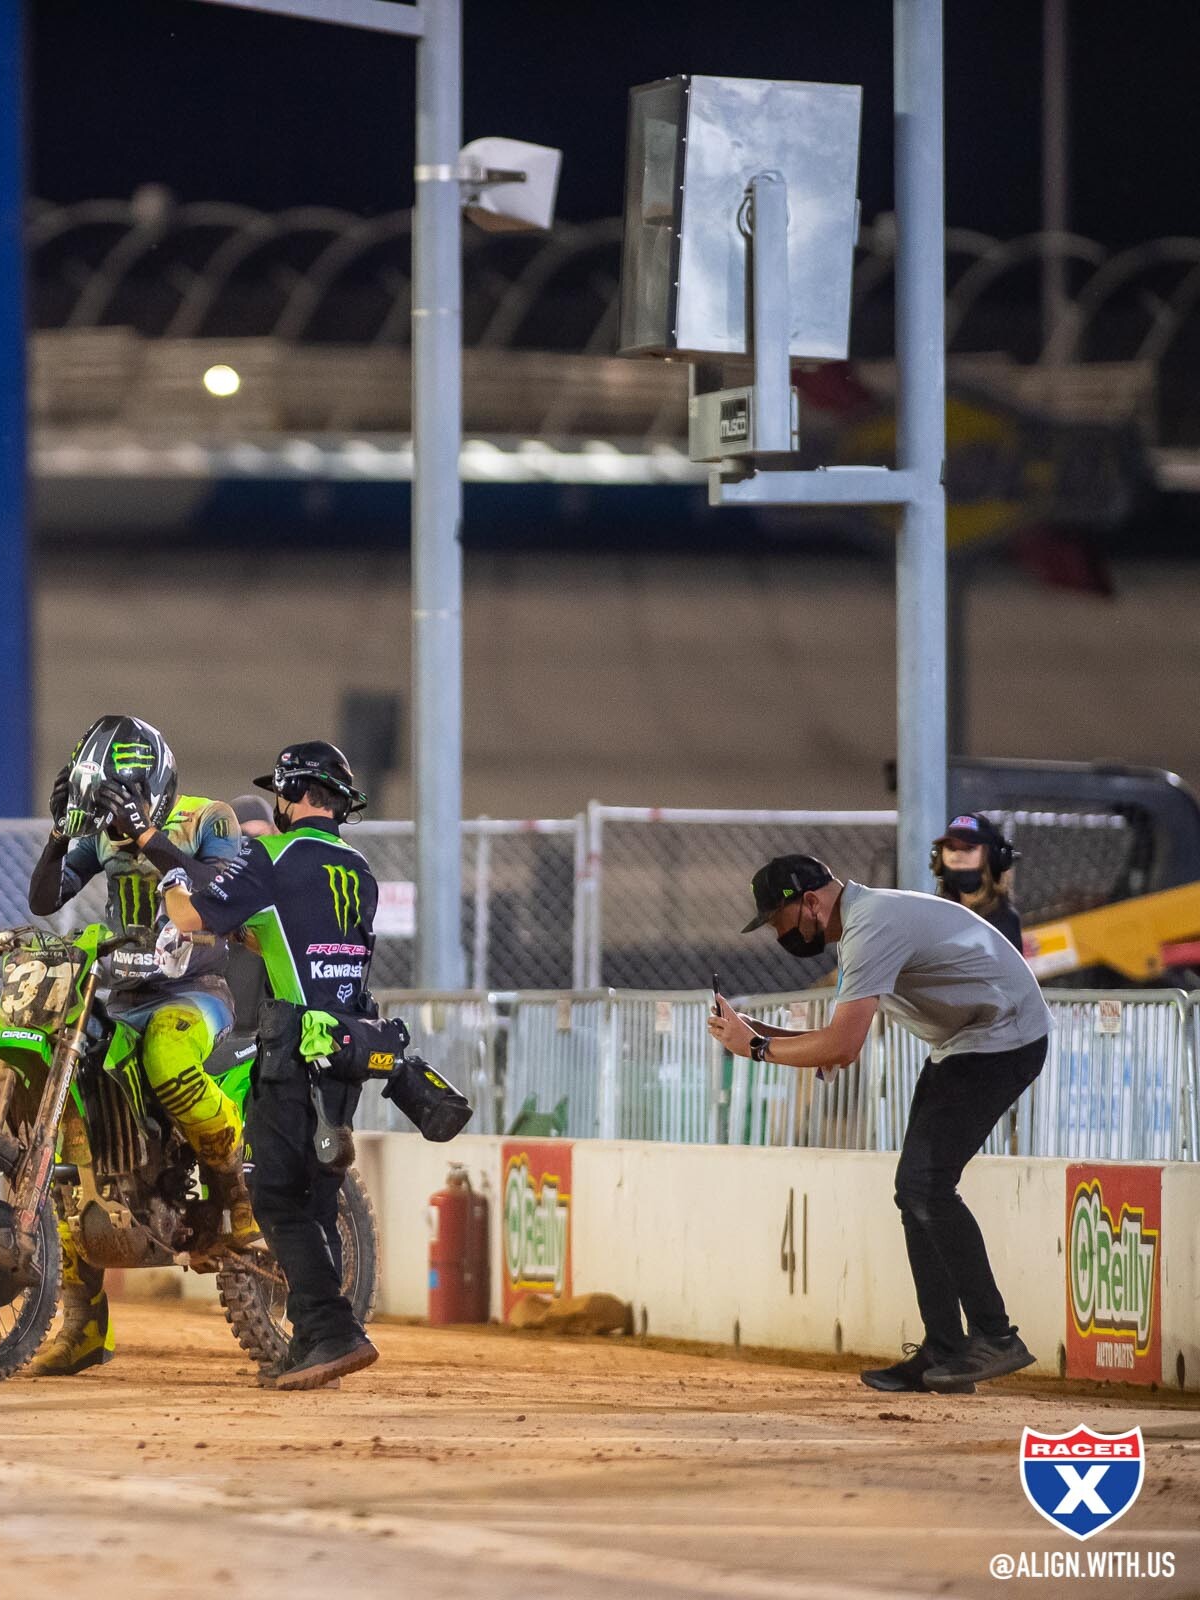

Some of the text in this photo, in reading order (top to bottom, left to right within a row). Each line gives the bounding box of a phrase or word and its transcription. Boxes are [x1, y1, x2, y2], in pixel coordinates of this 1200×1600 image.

[125, 802, 146, 830] FOX
[1, 959, 81, 1014] 31
[780, 1186, 807, 1295] 41
[1072, 1198, 1153, 1336] O'Reilly
[1096, 1341, 1135, 1369] AUTO PARTS
